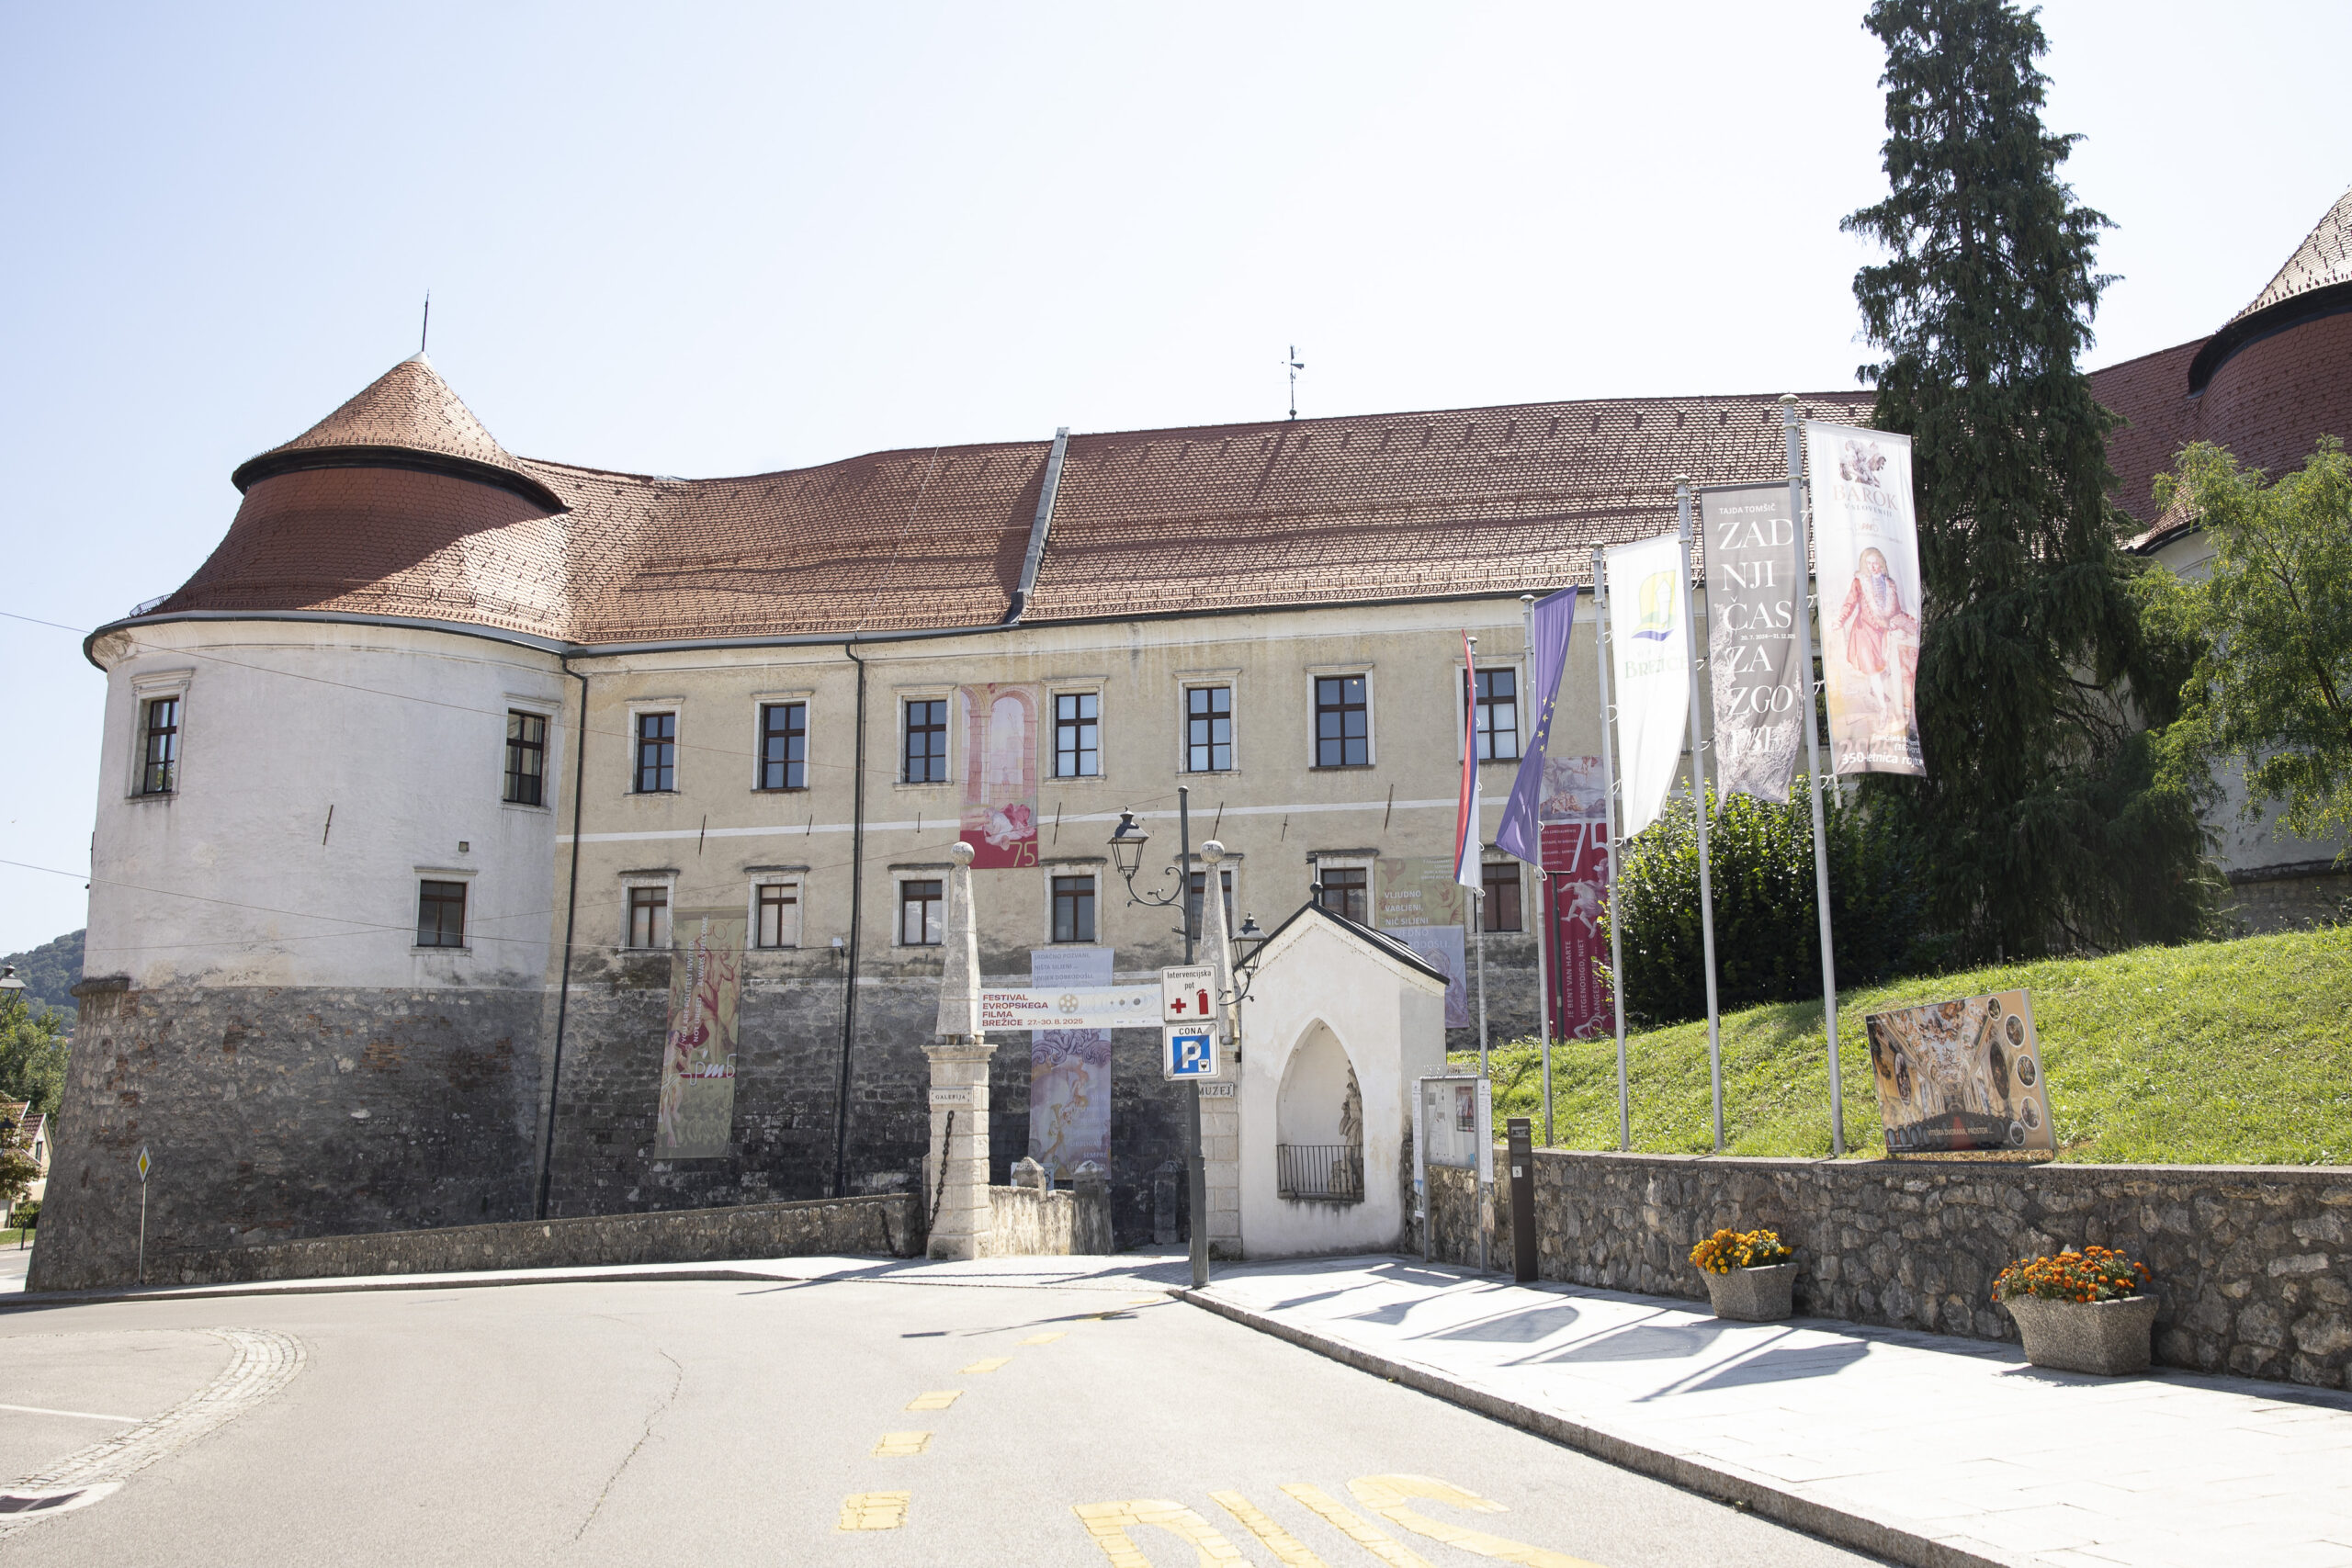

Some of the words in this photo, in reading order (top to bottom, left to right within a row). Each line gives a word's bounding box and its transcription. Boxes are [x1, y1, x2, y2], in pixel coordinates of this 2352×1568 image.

[1833, 484, 1898, 511] BAROK
[1719, 507, 1744, 515] TAJDA
[1717, 518, 1795, 550] ZAD
[1721, 559, 1778, 592] NJI
[1723, 595, 1792, 632] ČAS
[1725, 644, 1775, 673] ZA
[1727, 684, 1794, 716] ZGO
[1009, 840, 1038, 868] 75
[1384, 889, 1422, 899] VLJUDNO
[1385, 903, 1424, 912] VABLJENI,
[1401, 917, 1430, 926] SILJENI
[696, 955, 707, 987] ALWAYS
[1167, 970, 1212, 979] Intervencijska
[684, 973, 693, 1008] POLITELY
[1184, 982, 1195, 990] pot
[1578, 958, 1588, 1018] UITGENODIGD,
[695, 997, 703, 1026] URGED
[1567, 1010, 1575, 1019] JE
[982, 1018, 1023, 1027] BREŽICE
[1179, 1027, 1203, 1036] CONA
[1199, 1086, 1231, 1096] MUZEJ
[1967, 1126, 1989, 1135] PROSTOR
